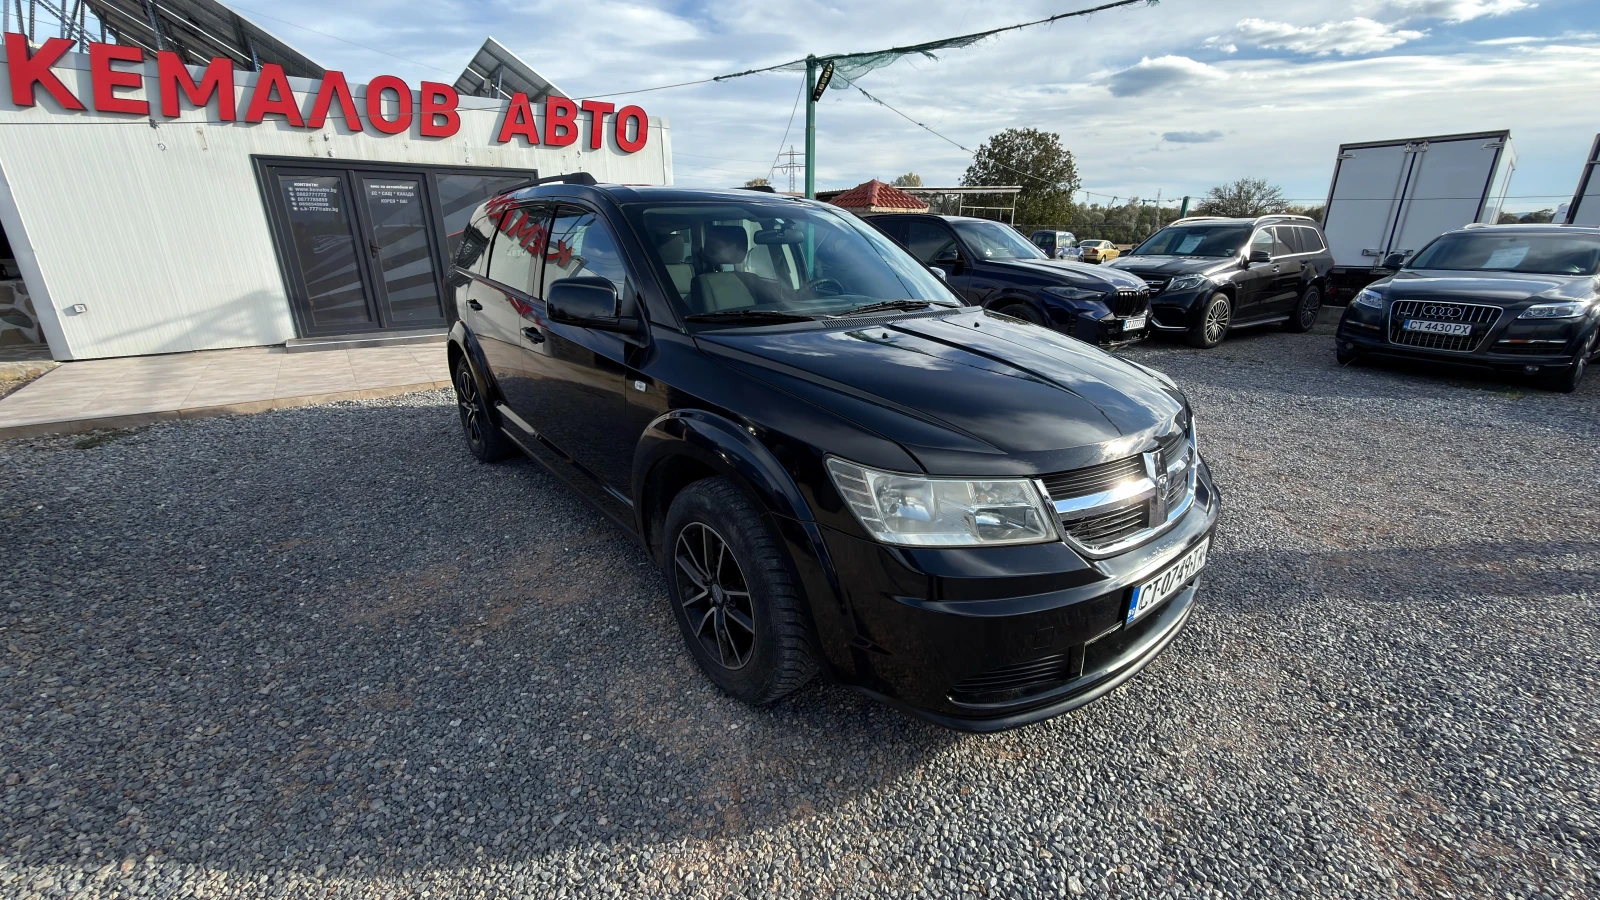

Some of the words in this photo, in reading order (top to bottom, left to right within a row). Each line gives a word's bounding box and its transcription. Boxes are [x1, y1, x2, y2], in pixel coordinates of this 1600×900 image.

[4, 31, 461, 137] КЕМАЛОВ
[497, 91, 649, 153] АВТО
[1409, 320, 1424, 330] CT
[1424, 322, 1452, 333] 4430
[1453, 324, 1470, 335] PX
